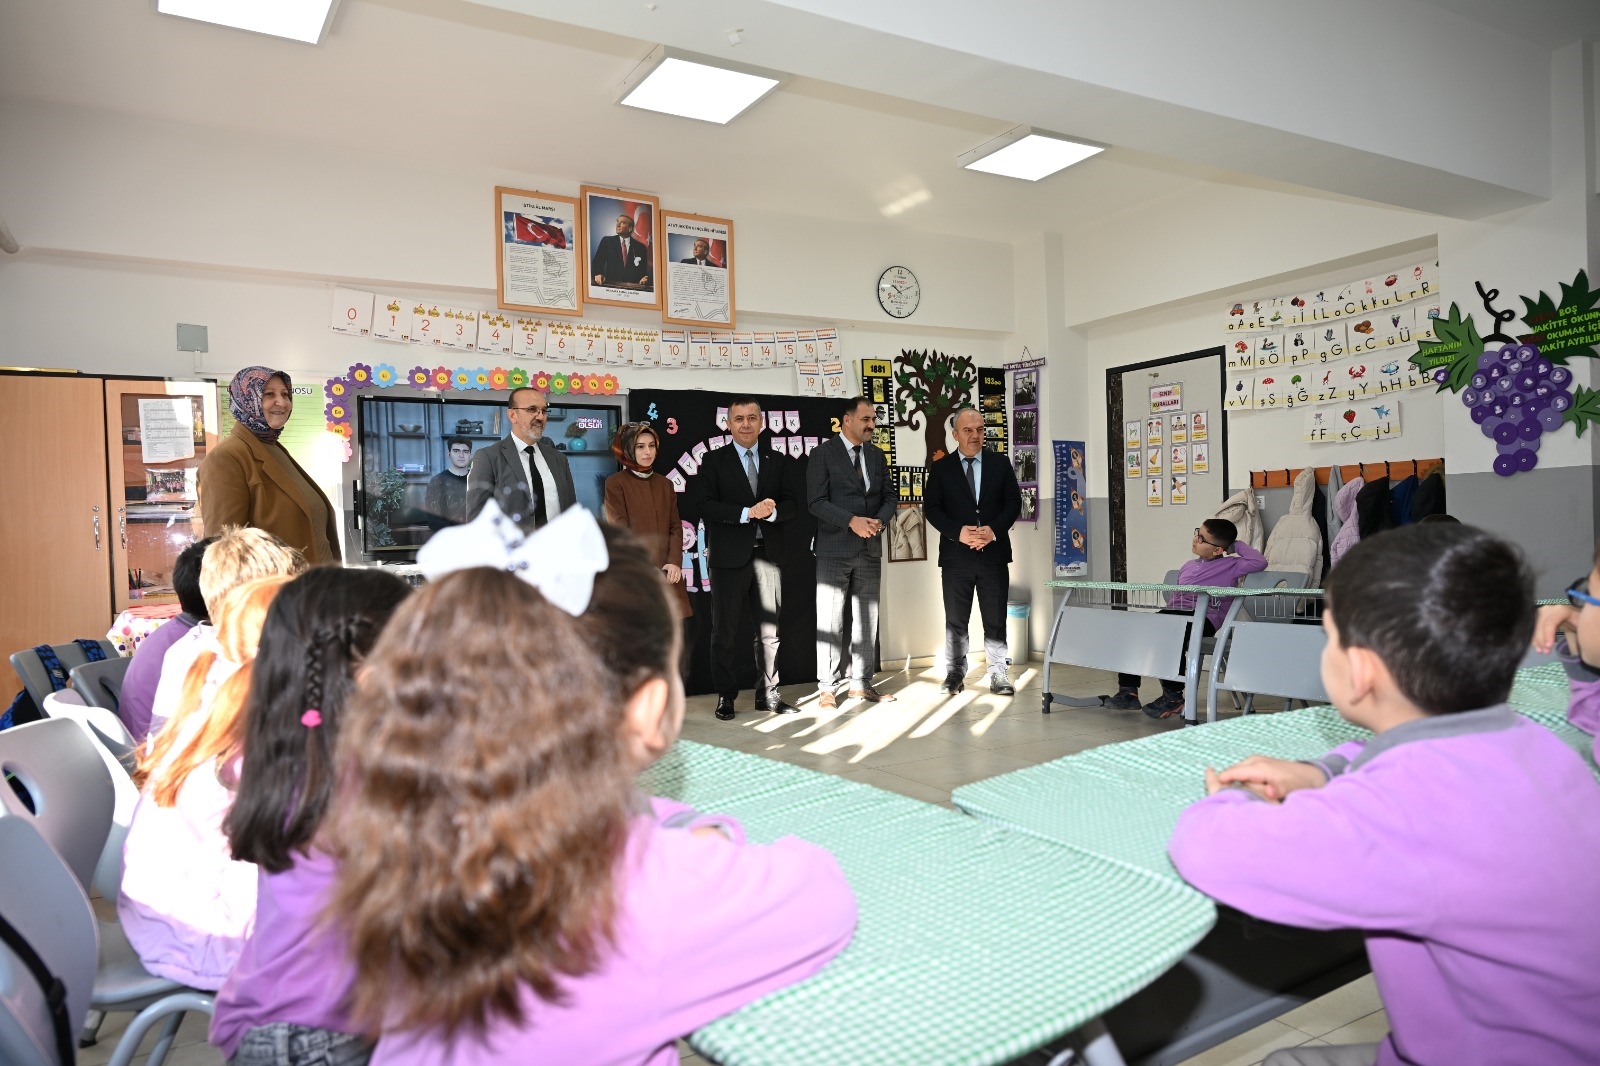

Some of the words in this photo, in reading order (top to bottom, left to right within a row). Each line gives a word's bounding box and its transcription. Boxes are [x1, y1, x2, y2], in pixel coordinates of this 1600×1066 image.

[1259, 317, 1266, 328] E
[1322, 308, 1330, 319] L
[1422, 282, 1430, 294] R
[1559, 305, 1578, 317] BOŞ
[348, 308, 357, 320] 0
[391, 315, 396, 327] 1
[421, 320, 430, 332] 2
[456, 324, 463, 336] 3
[492, 329, 500, 341] 4
[526, 334, 534, 346] 5
[558, 338, 566, 349] 6
[587, 340, 594, 350] 7
[617, 342, 624, 353] 8
[644, 345, 651, 355] 9
[669, 344, 680, 356] 10
[699, 346, 707, 356] 11
[718, 346, 729, 357] 12
[740, 346, 749, 357] 13
[760, 346, 771, 356] 14
[784, 344, 794, 355] 15
[804, 343, 814, 354] 16
[824, 342, 833, 351] 17
[1531, 319, 1568, 334] VAKİTTE
[1547, 326, 1586, 340] OKUMAK
[1240, 356, 1251, 366] M
[1269, 350, 1279, 364] Ö
[1292, 356, 1298, 366] p
[1302, 349, 1308, 360] P
[1320, 352, 1327, 362] g
[1331, 344, 1343, 356] G
[1366, 338, 1376, 350] C
[1387, 336, 1395, 345] ü
[1400, 327, 1411, 342] Ü
[1422, 341, 1463, 357] HAFTANIN
[1538, 340, 1566, 354] VAKİT
[1429, 355, 1455, 366] YILDIZI
[870, 365, 886, 373] 1881
[806, 378, 815, 388] 19
[829, 377, 841, 388] 20
[1239, 395, 1248, 406] V
[1298, 388, 1309, 402] Ğ
[1328, 387, 1337, 400] Z
[1349, 390, 1355, 401] y
[1359, 382, 1368, 394] Y
[1380, 381, 1388, 393] h
[1390, 378, 1402, 391] H
[1409, 375, 1416, 387] b
[1422, 372, 1431, 384] B
[667, 418, 678, 434] 3
[831, 418, 842, 432] 2
[1311, 430, 1317, 440] f
[1320, 429, 1327, 440] F
[1351, 426, 1361, 440] Ç
[1384, 422, 1390, 434] J
